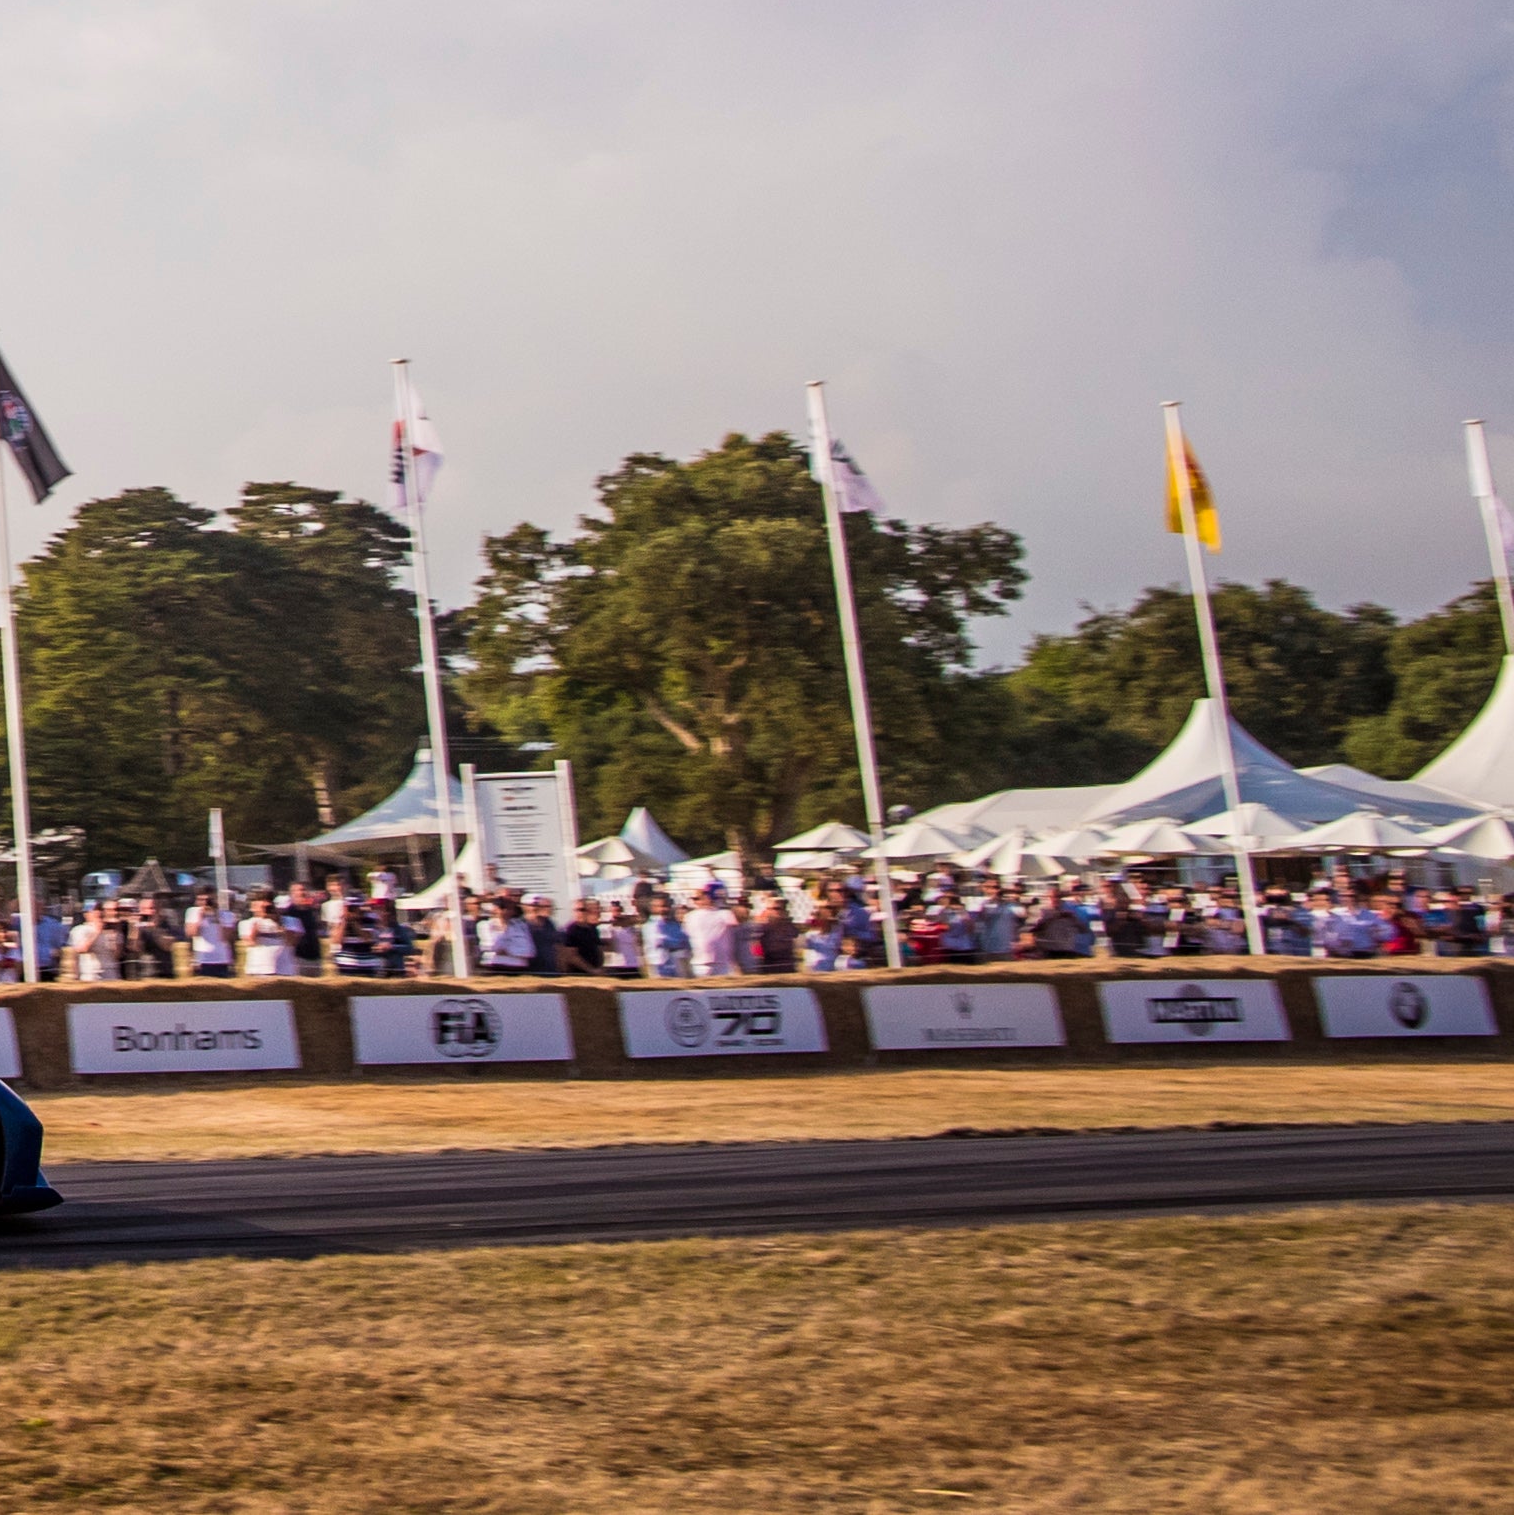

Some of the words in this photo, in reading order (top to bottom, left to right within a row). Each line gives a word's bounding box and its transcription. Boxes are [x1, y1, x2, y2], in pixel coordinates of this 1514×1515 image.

[112, 1023, 263, 1052] Bonhams
[433, 1012, 497, 1044] FIA
[712, 1011, 783, 1035] 70
